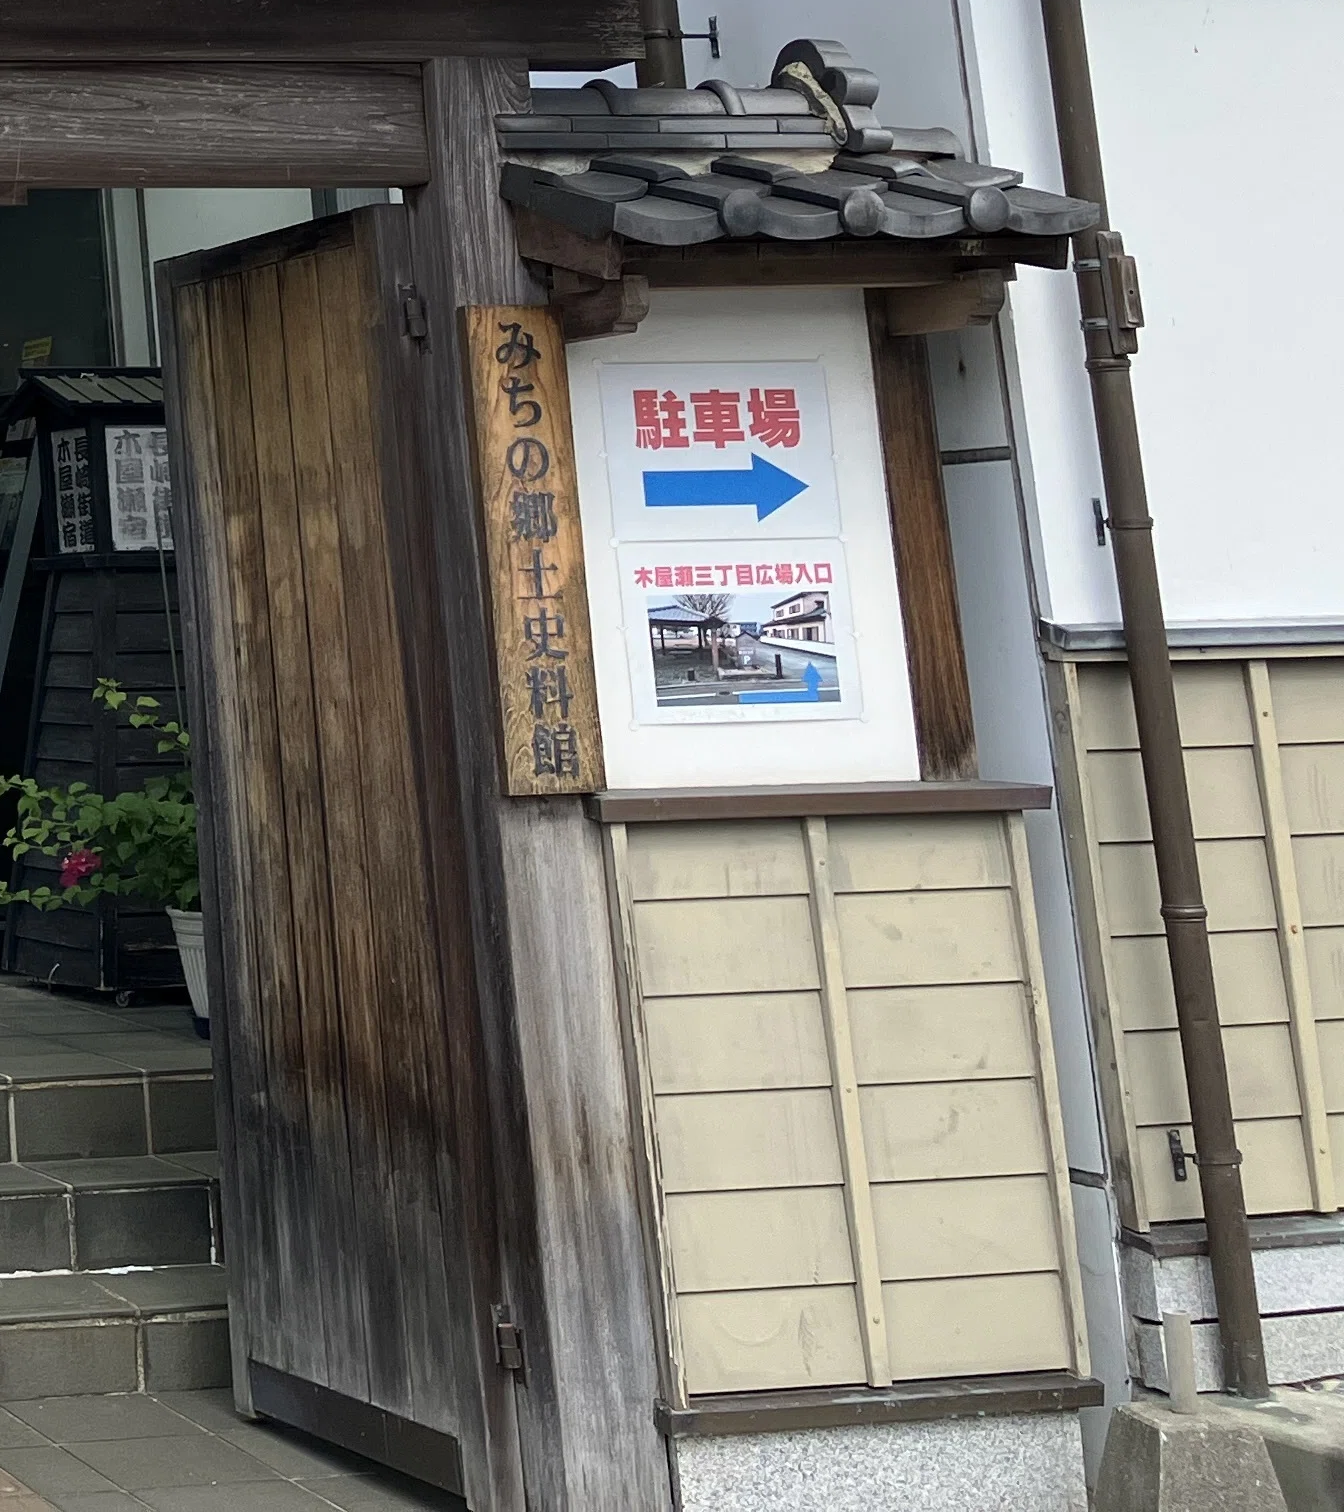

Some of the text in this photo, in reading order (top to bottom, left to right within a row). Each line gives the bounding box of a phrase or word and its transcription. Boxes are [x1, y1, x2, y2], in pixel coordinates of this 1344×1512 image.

[633, 388, 801, 451] 駐車場
[494, 321, 580, 779] みちの郷土史料館
[634, 562, 833, 588] 木屋瀬三丁目広場入口
